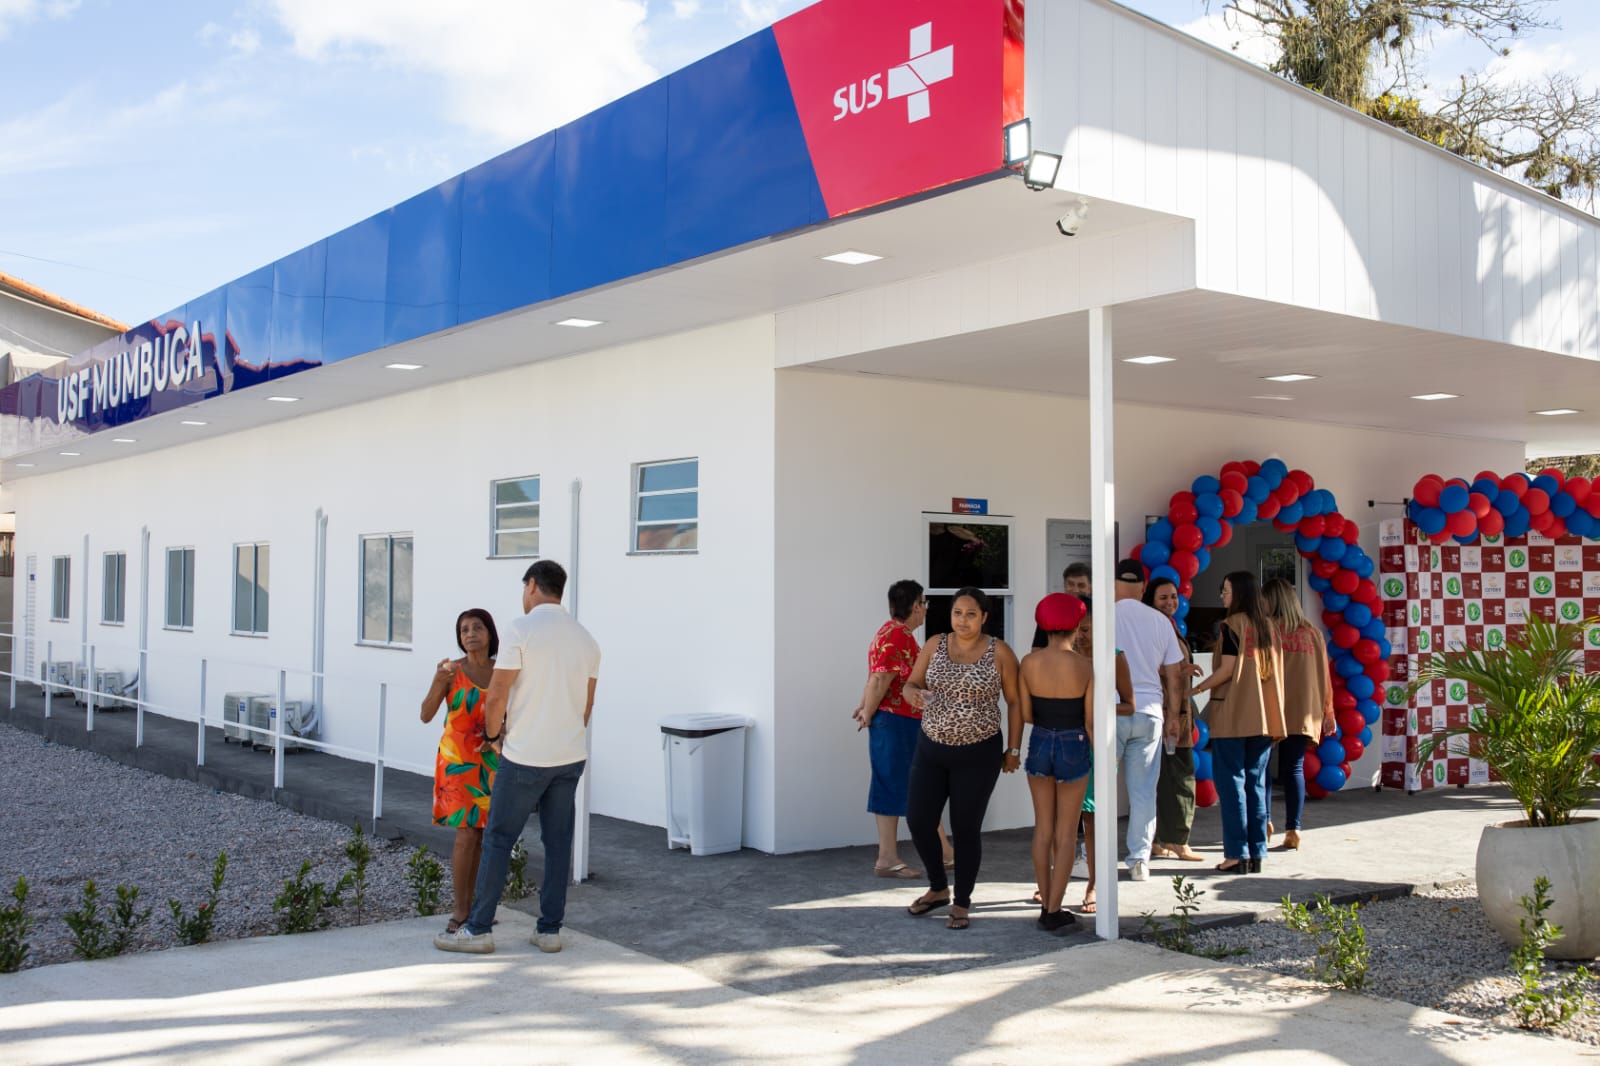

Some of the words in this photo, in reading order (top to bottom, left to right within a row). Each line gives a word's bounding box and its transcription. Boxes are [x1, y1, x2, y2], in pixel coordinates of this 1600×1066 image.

[833, 72, 883, 122] SUS
[57, 368, 89, 425] USF
[92, 320, 206, 413] MUMBUCA
